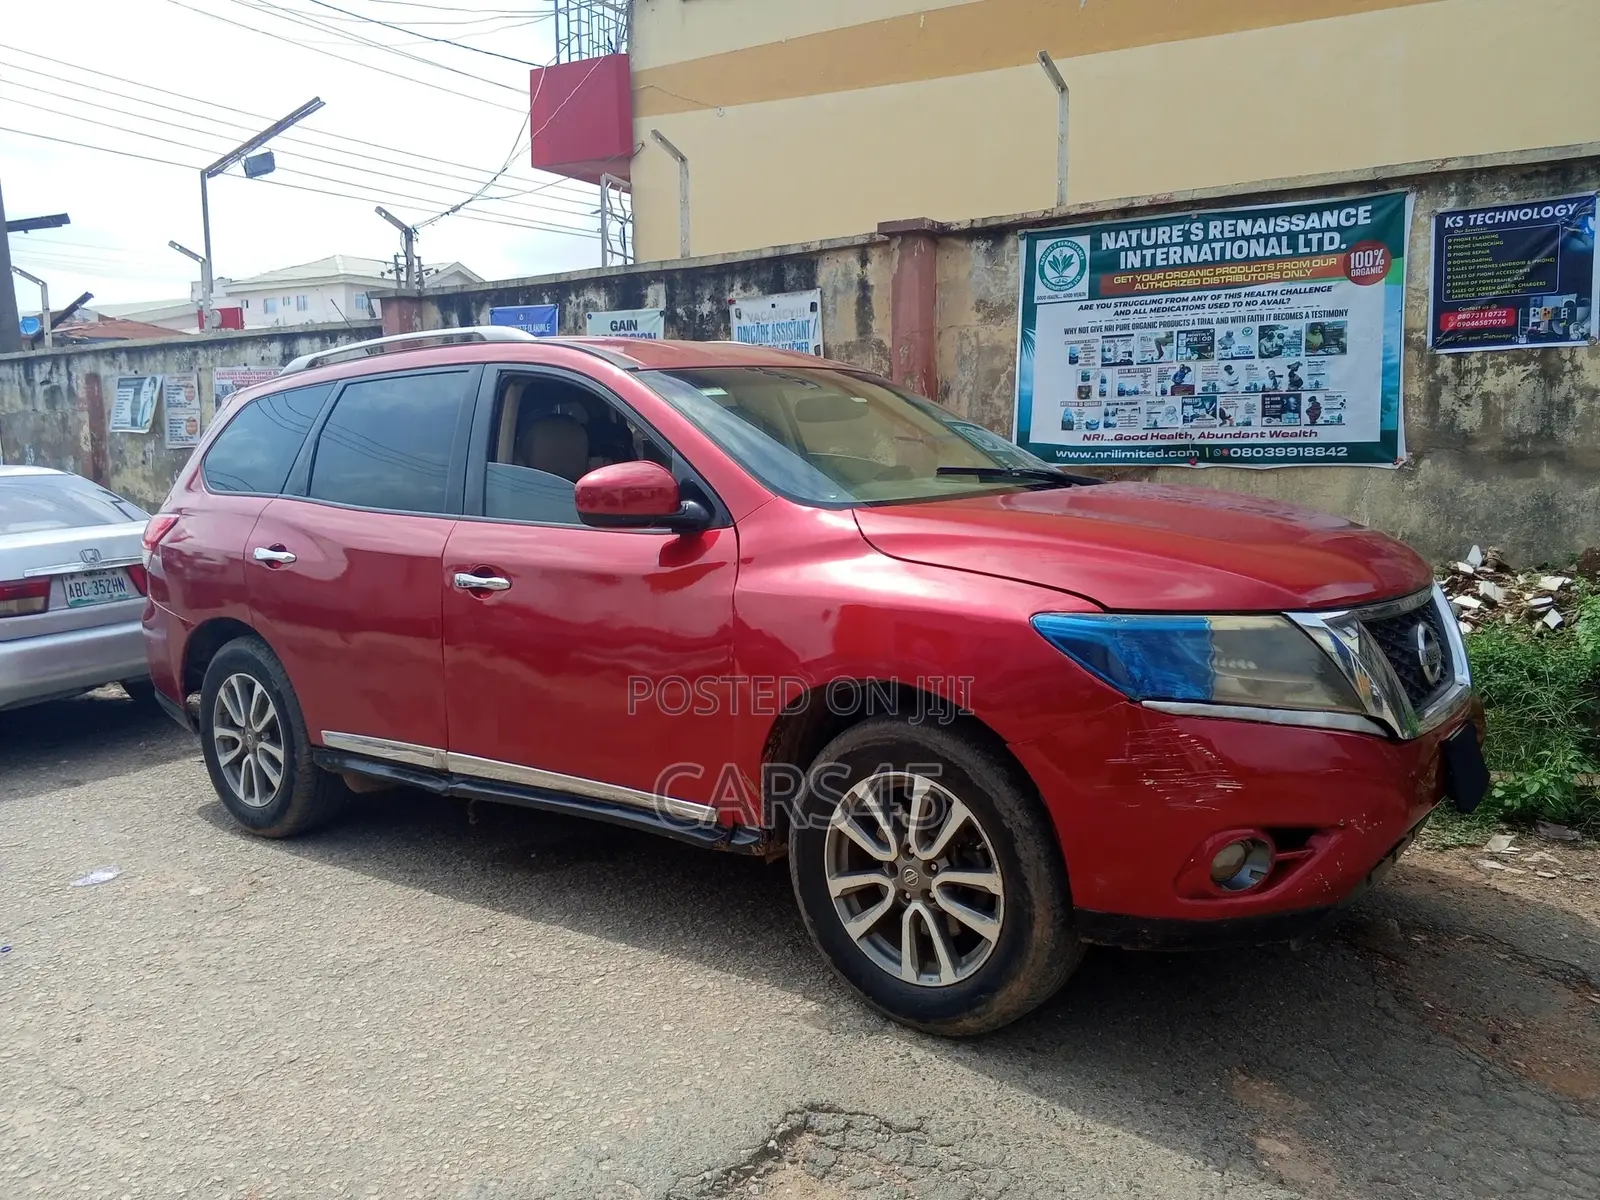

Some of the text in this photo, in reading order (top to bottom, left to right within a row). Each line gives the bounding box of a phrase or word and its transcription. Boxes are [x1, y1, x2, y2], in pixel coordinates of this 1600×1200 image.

[1444, 202, 1578, 228] KS TECHNOLOGY
[1101, 205, 1372, 250] NATURE'S RENAISSANCE
[1120, 232, 1347, 270] INTERNATIONAL LTD.
[1350, 248, 1385, 269] 100%
[1114, 258, 1337, 284] GET YOUR ORGANIC PRODUCTS FROM OUR
[1134, 269, 1313, 291] AUTHORIZED DISTRIBUTORS ONLY
[1351, 266, 1383, 277] ORGANIC
[1113, 299, 1164, 309] STRUGGLING
[1244, 289, 1278, 298] HEALTH
[1280, 285, 1333, 296] CHALLENGE
[1149, 304, 1206, 314] MEDICATIONS
[1260, 298, 1291, 306] AVAIL?
[610, 320, 638, 332] GAIN
[1090, 325, 1104, 333] GIVE
[1116, 323, 1130, 331] PURE
[1131, 321, 1158, 330] ORGANIC
[1159, 319, 1190, 328] PRODUCTS
[1197, 317, 1214, 325] TRIAL
[1216, 316, 1229, 324] AND
[1230, 315, 1246, 324] WITH
[1248, 314, 1265, 323] FAITH
[1273, 311, 1304, 321] BECOMES
[1311, 308, 1349, 318] TESTIMONY
[1457, 311, 1507, 320] 08073110732
[1457, 319, 1506, 327] 09046587070
[738, 324, 770, 343] DAYCARE
[772, 320, 810, 341] ASSISTANT
[1150, 431, 1195, 441] Health,
[1198, 430, 1266, 440] Abundant
[1269, 429, 1318, 439] Wealth
[1056, 449, 1200, 459] www.nrilimited.com
[1230, 447, 1348, 457] 08039918842
